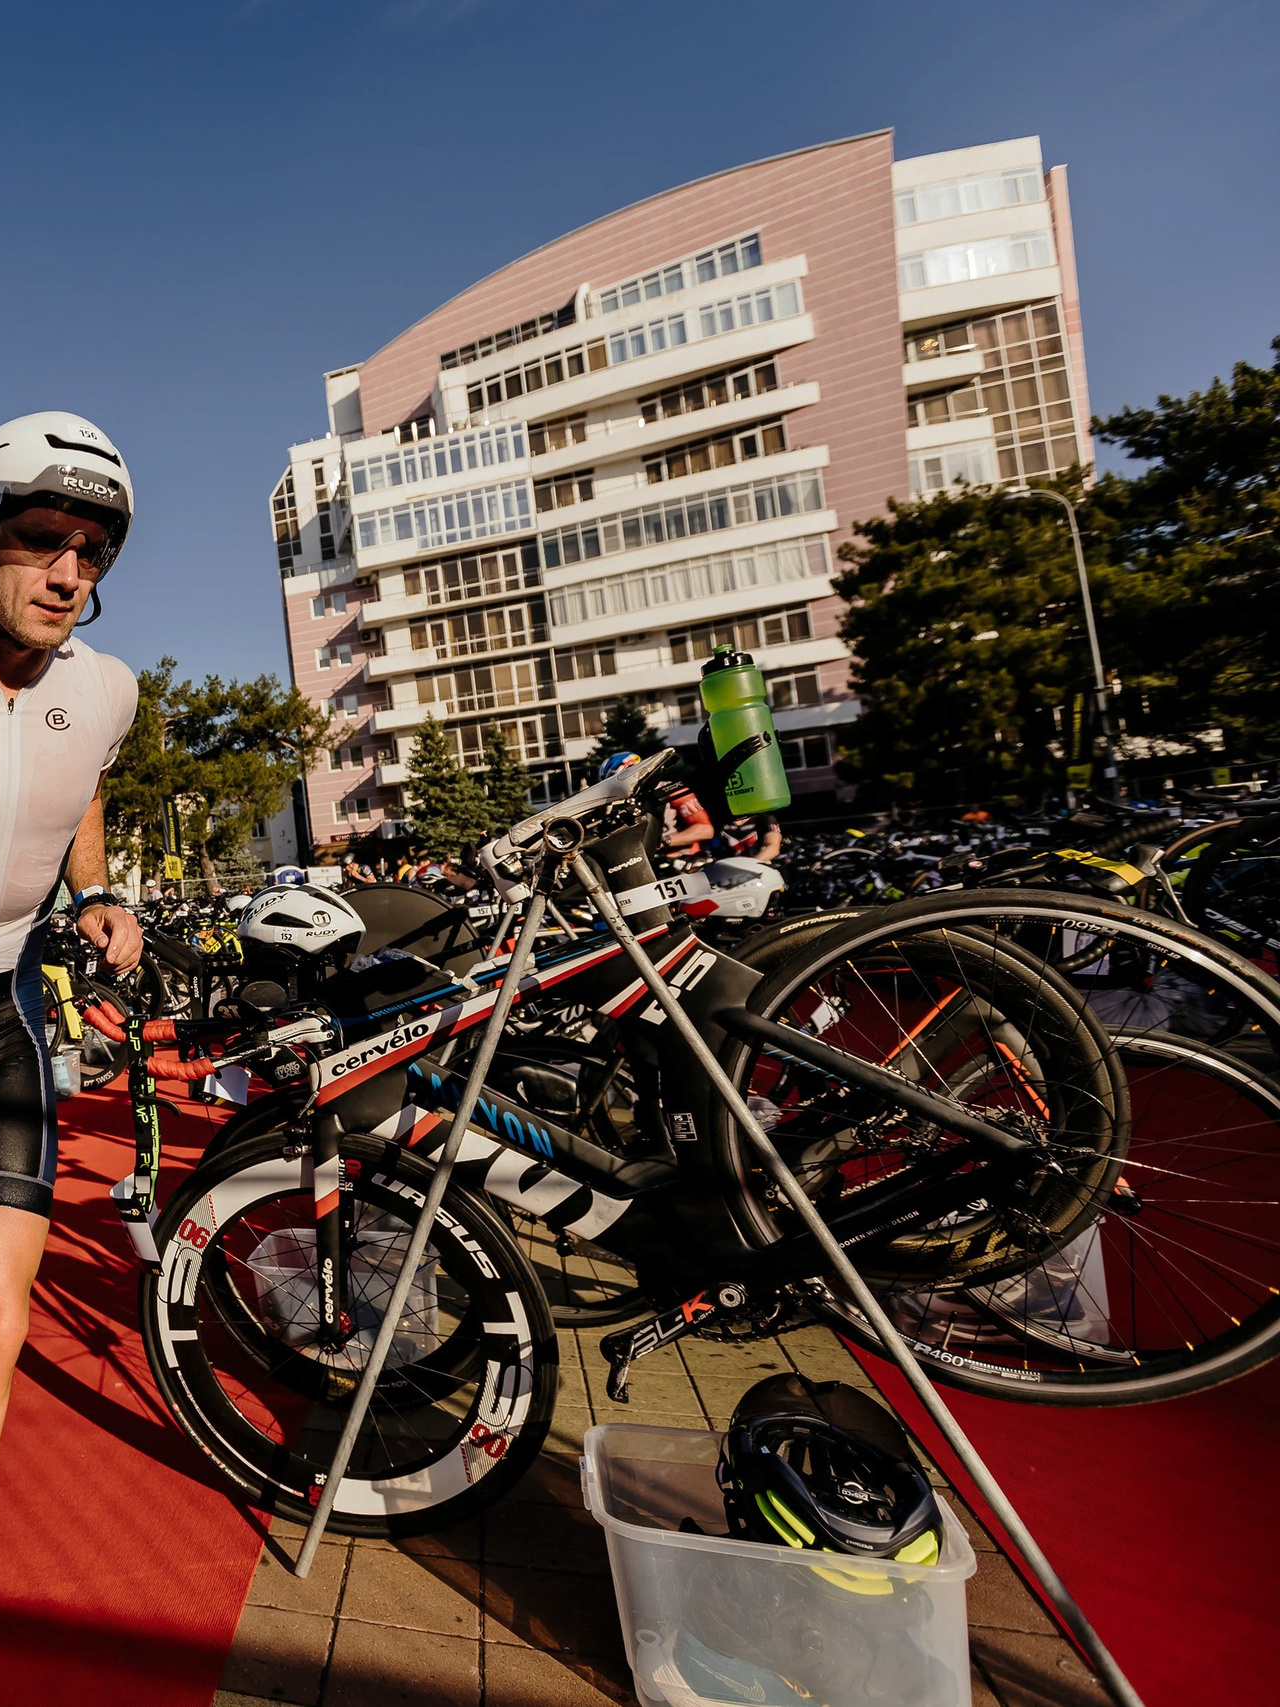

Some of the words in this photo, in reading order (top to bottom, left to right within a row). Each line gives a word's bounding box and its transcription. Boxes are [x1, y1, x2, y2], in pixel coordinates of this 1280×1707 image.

[79, 429, 98, 441] 156
[62, 476, 118, 499] RUDY
[654, 878, 688, 901] 151
[246, 892, 288, 925] RUDY
[305, 929, 339, 938] RUDY
[779, 911, 861, 935] CONTINENTAL
[280, 932, 293, 941] 152
[190, 976, 199, 999] SUUNTO
[217, 1004, 240, 1020] 3T
[331, 1023, 429, 1077] cervélo
[83, 1080, 95, 1088] DT
[96, 1070, 115, 1085] SWISS
[178, 1218, 211, 1249] 90
[371, 1172, 501, 1280] URSUS
[324, 1257, 334, 1324] cervélo
[632, 1289, 715, 1359] SL-K
[692, 1306, 716, 1325] LIGHT
[913, 1341, 966, 1368] R460
